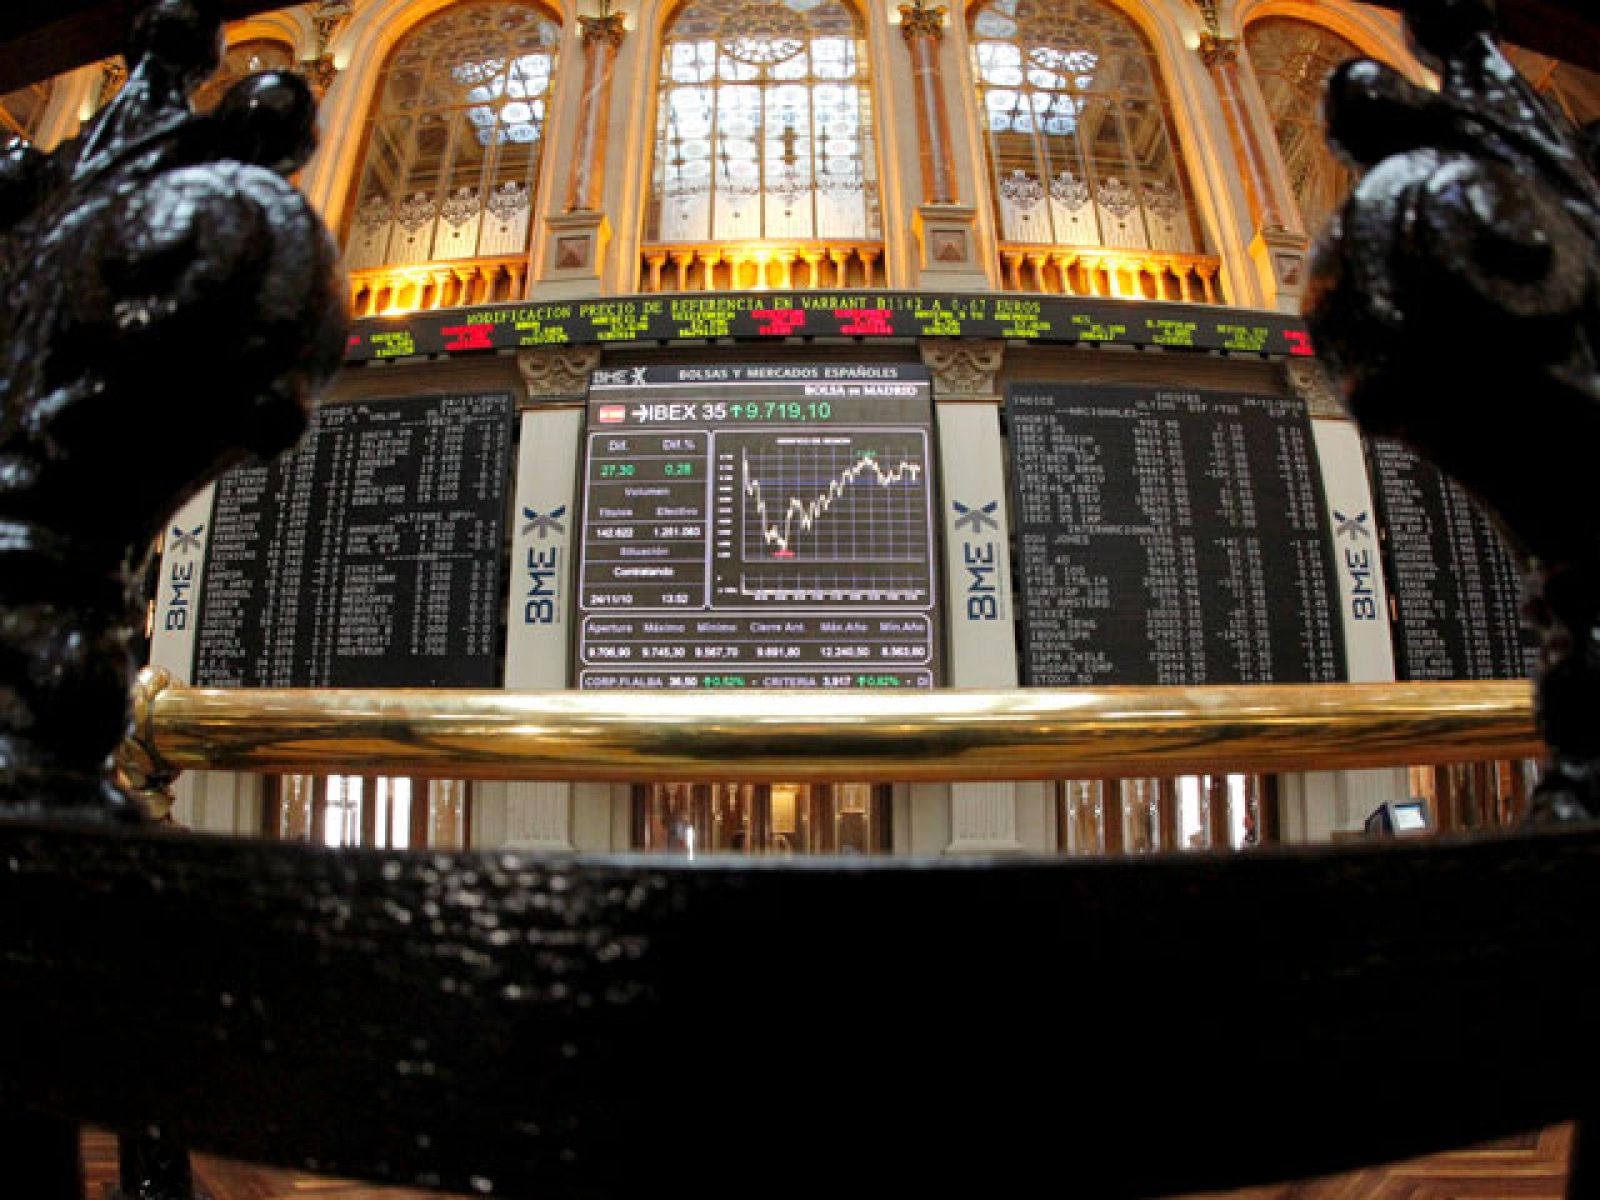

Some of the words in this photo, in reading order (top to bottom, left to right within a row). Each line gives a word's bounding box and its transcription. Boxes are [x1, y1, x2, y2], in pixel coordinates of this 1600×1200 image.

[467, 305, 571, 324] MODIFICACION
[579, 303, 634, 317] PRECIO
[643, 300, 663, 314] DE
[773, 297, 793, 310] EN
[679, 369, 730, 381] BOLSAS
[732, 369, 741, 380] Y
[746, 367, 819, 379] MERCADOS
[824, 365, 899, 379] ESPAÑOLES
[649, 404, 698, 421] IBEX
[702, 403, 727, 421] 35
[744, 402, 831, 421] 9.719,10
[165, 559, 193, 631] BME
[525, 546, 557, 624] BME
[963, 541, 997, 621] BME
[1343, 547, 1376, 621] BME
